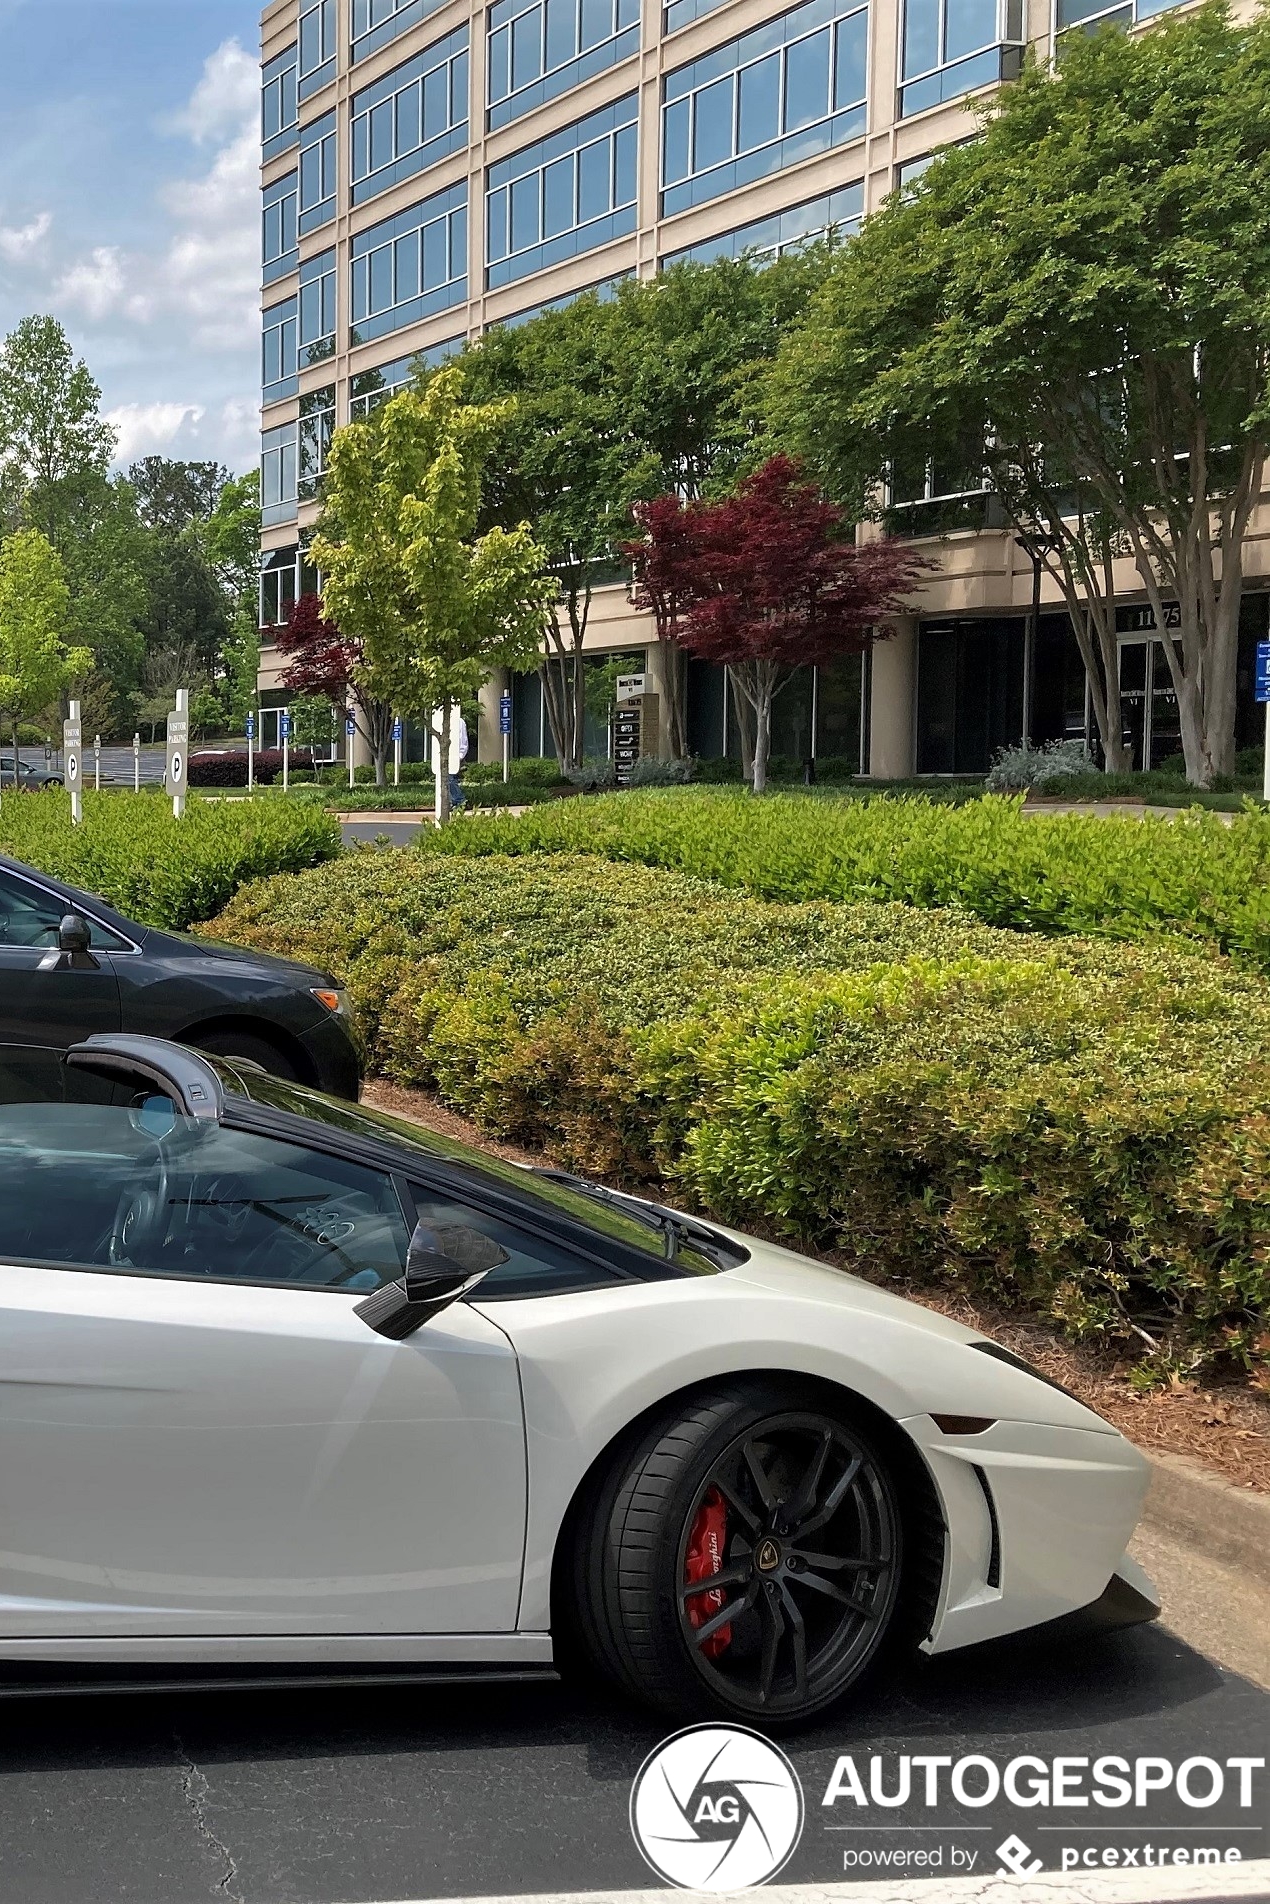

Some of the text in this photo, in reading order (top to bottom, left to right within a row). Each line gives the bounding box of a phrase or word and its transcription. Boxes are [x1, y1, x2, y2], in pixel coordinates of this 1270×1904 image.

[1138, 608, 1180, 627] 1175
[170, 721, 187, 732] VISITOR
[169, 733, 187, 744] PARKING
